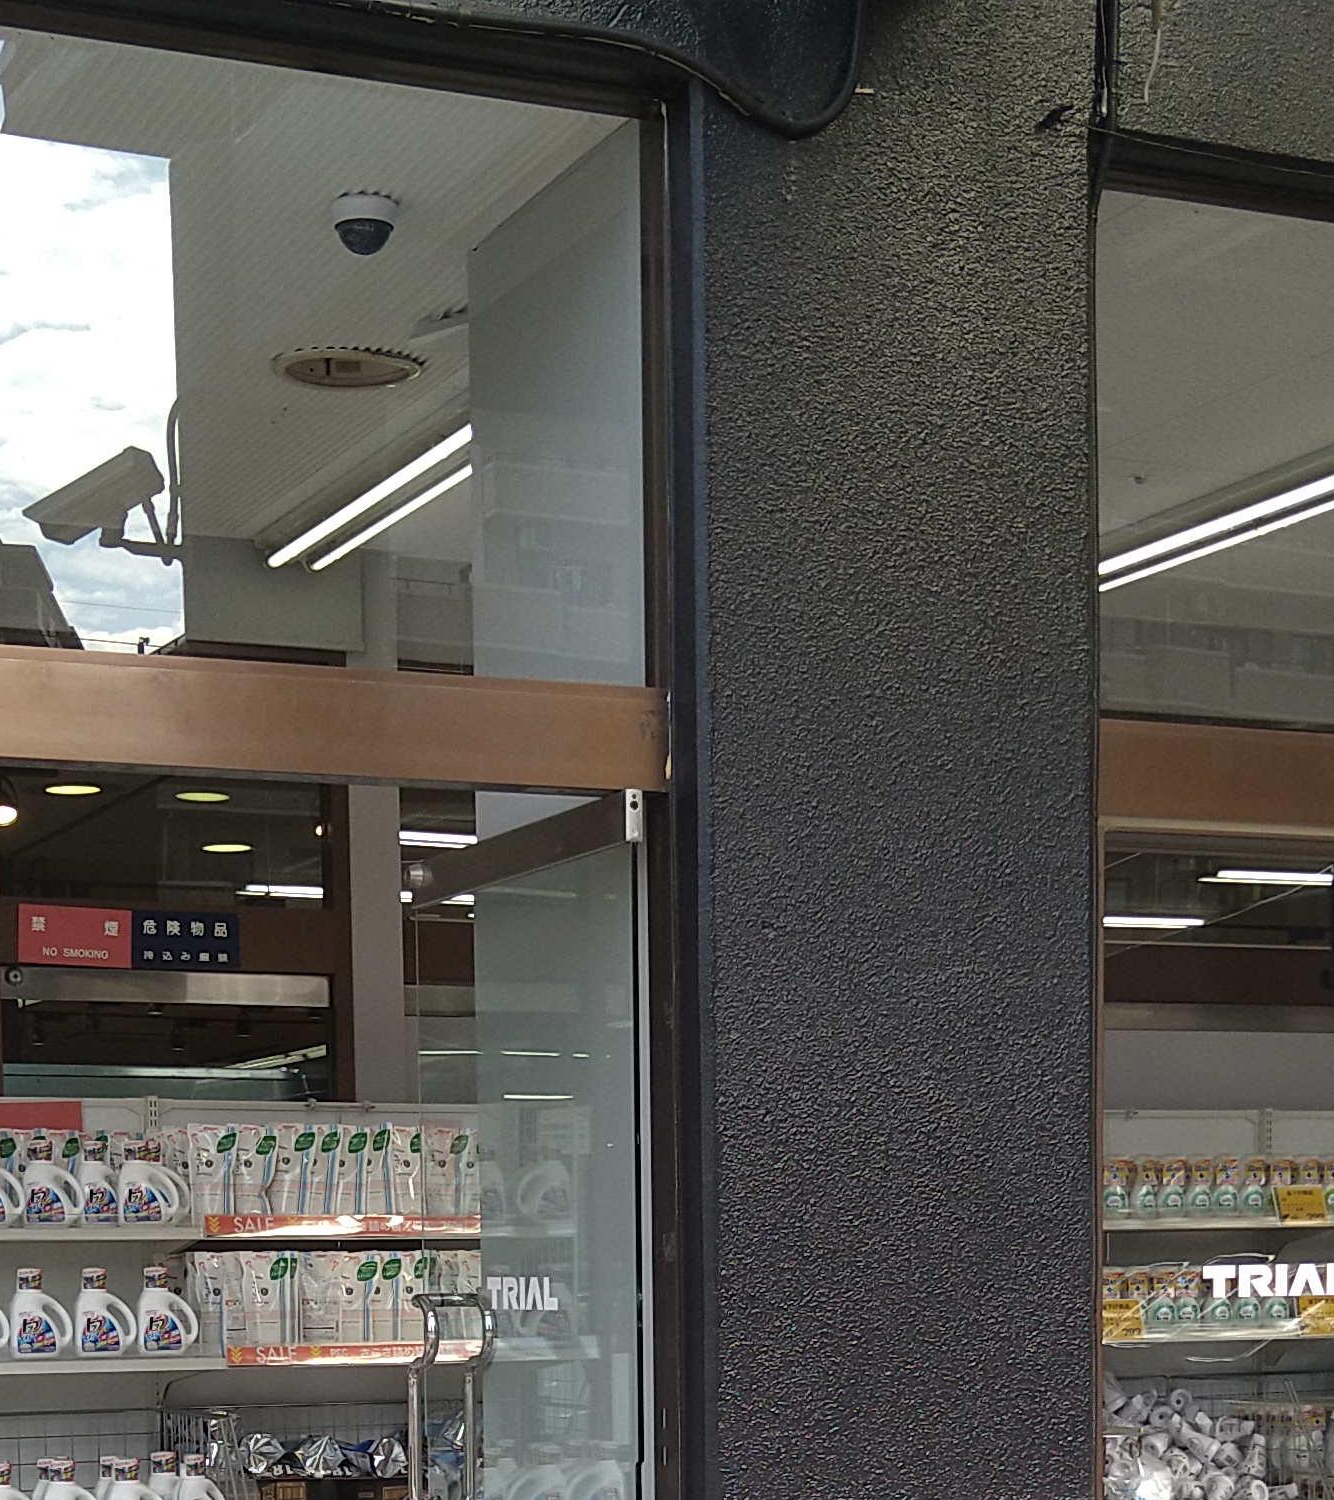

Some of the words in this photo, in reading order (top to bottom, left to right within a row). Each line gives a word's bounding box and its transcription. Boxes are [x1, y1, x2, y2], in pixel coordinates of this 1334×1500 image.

[31, 916, 119, 937] 禁煙
[143, 919, 228, 938] 危険物品
[42, 946, 58, 957] NO
[63, 947, 109, 960] SMOKING
[487, 1277, 559, 1311] TRIAL
